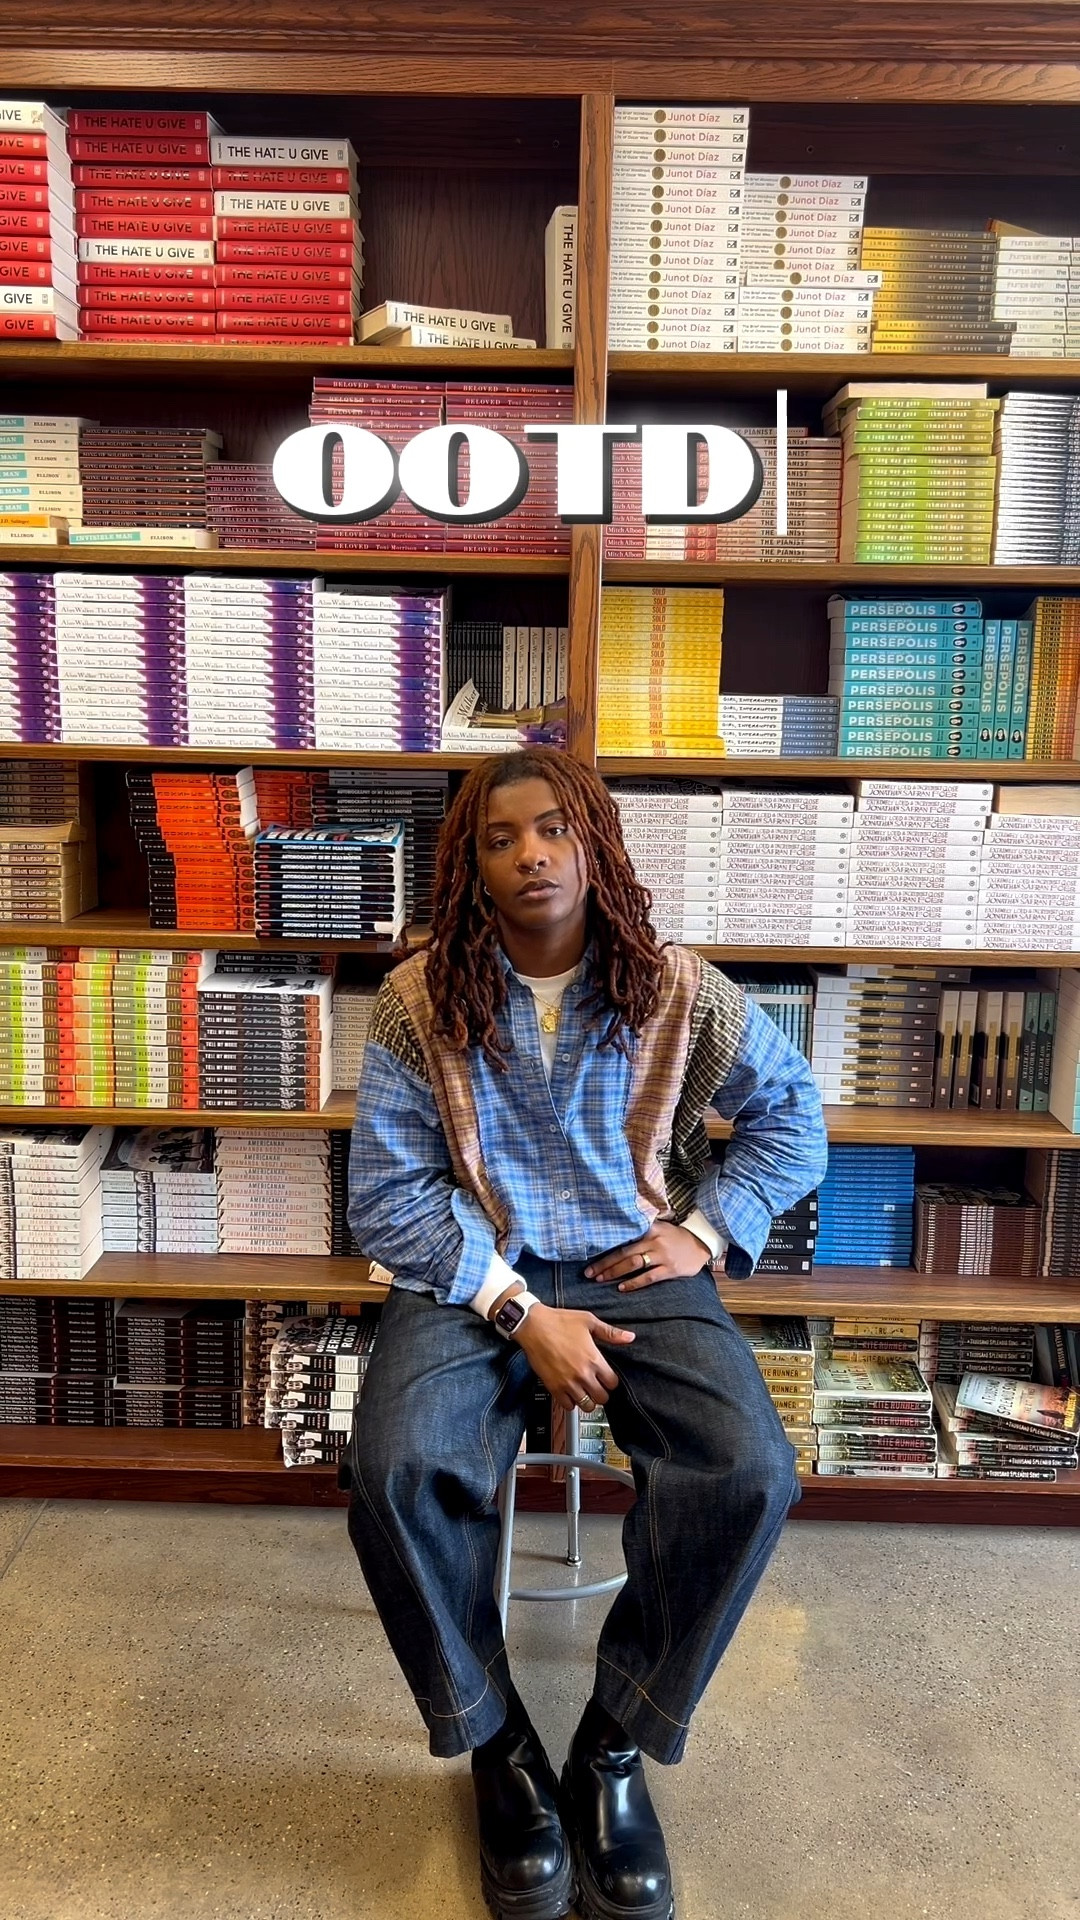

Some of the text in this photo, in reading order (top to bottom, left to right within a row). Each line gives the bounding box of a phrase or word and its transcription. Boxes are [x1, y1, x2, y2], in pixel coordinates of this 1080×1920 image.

[668, 113, 695, 122] Junot
[84, 116, 186, 130] THE HATE U GIVE
[668, 133, 695, 142] Junot
[85, 142, 187, 155] THE HATE U GIVE
[228, 146, 329, 160] THE HATE U GIVE
[668, 152, 695, 161] Junot
[666, 169, 693, 178] Junot
[793, 179, 820, 188] Junot
[666, 188, 693, 197] Junot
[231, 199, 330, 212] THE HATE U GIVE
[665, 205, 693, 214] Junot
[91, 220, 192, 233] THE HATE U GIVE
[563, 224, 573, 248] THE
[1, 242, 28, 252] GIVE
[95, 245, 195, 258] THE HATE U GIVE
[1, 267, 29, 277] GIVE
[563, 254, 572, 285] HATE
[803, 274, 831, 283] Junot
[4, 293, 32, 304] GIVE
[795, 292, 822, 301] Junot
[404, 312, 496, 332] THE HATE U GIVE
[562, 303, 572, 333] GIVE
[5, 319, 34, 330] GIVE
[851, 606, 935, 615] PERSEPOLIS
[852, 622, 937, 631] PERSEPOLIS
[852, 638, 937, 647] PERSEPOLIS
[851, 654, 936, 663] PERSEPOLIS
[982, 626, 996, 712] PERSEPOLIS
[997, 627, 1011, 712] PERSEPOLIS
[1013, 628, 1028, 713] PERSEPOLIS
[851, 670, 935, 679] PERSEPOLIS
[851, 686, 935, 695] PERSEPOLIS
[457, 690, 476, 717] Walker
[848, 701, 933, 710] PERSEPOLIS
[849, 717, 933, 726] PERSEPOLIS
[326, 1318, 346, 1353] JERICHO
[341, 1325, 357, 1348] ROAD
